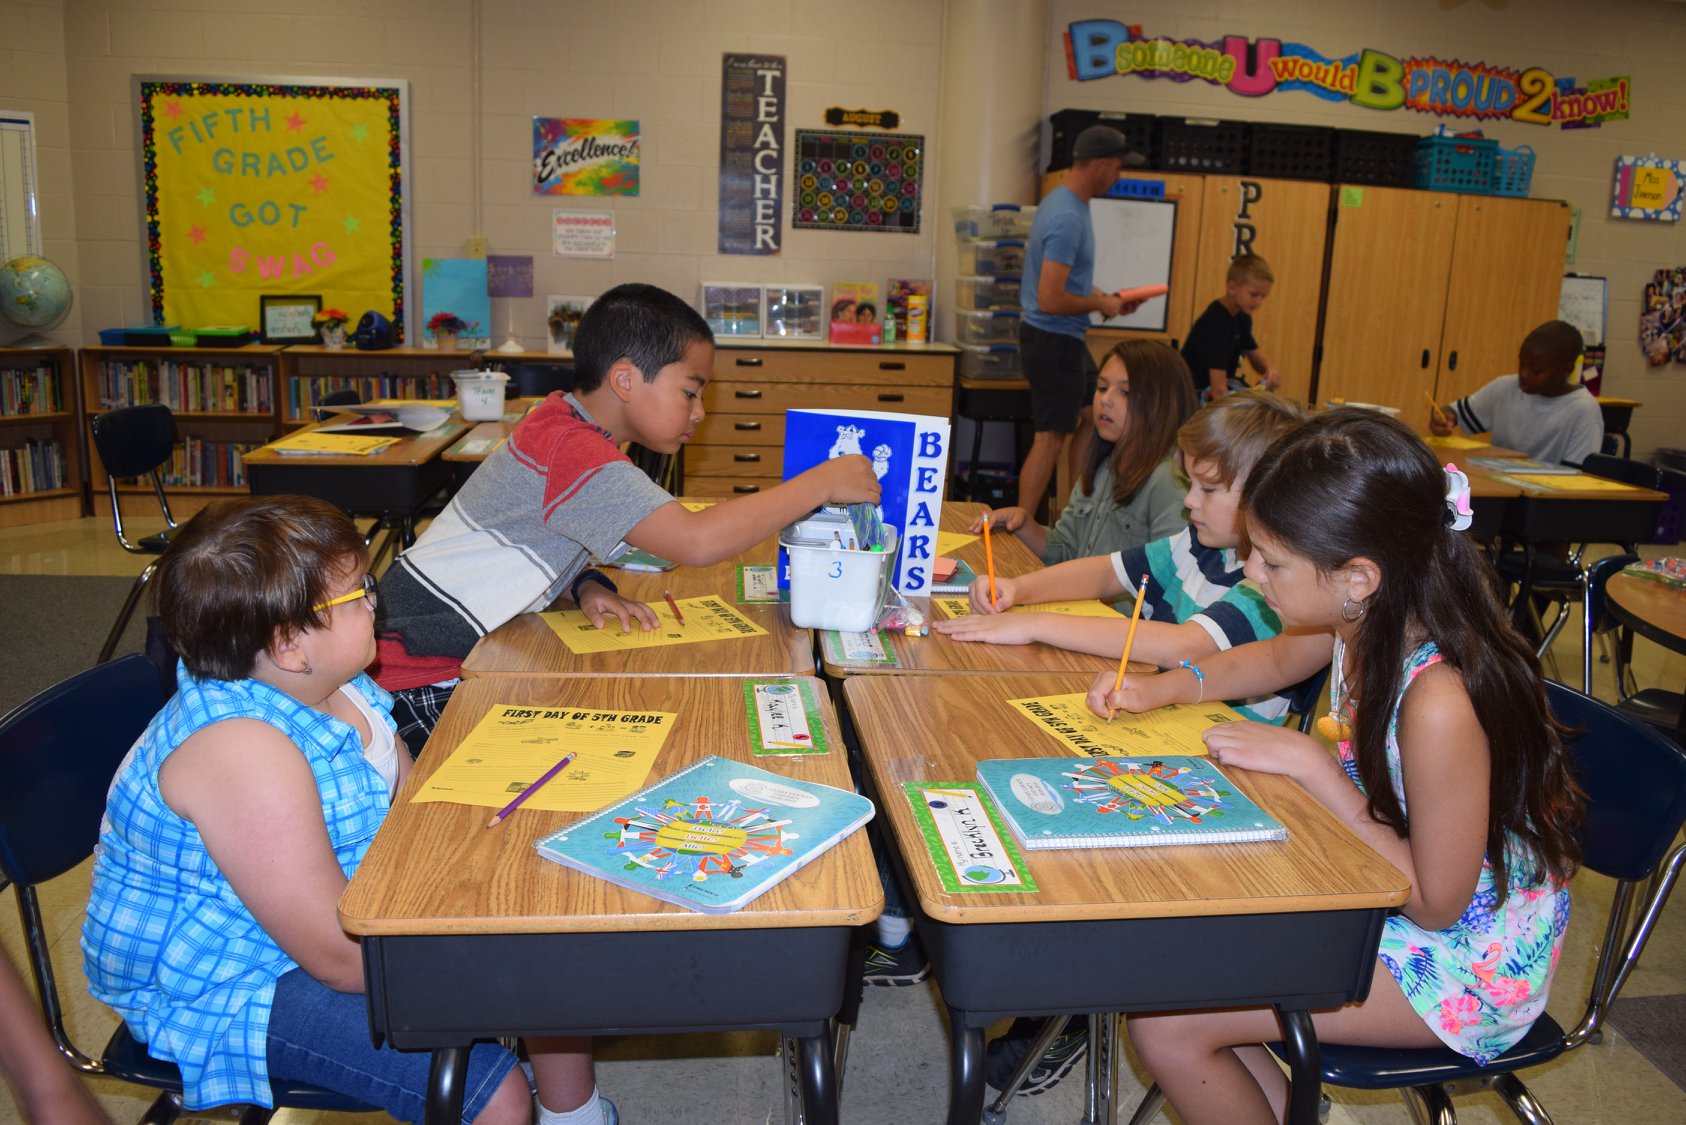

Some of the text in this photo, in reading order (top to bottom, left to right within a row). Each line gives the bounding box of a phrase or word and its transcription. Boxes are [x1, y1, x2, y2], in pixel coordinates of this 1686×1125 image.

[1068, 18, 1627, 125] B someone U would B PROUD 2 know!
[168, 107, 271, 154] FIFTH
[212, 136, 334, 177] GRADE
[537, 136, 638, 183] Excellence!
[753, 69, 781, 249] TEACHER
[229, 200, 307, 228] GOT
[228, 242, 336, 280] SWAG
[905, 432, 942, 590] BEARS
[828, 560, 843, 578] 3
[502, 709, 663, 724] FIRST DAY OF 5TH GRADE
